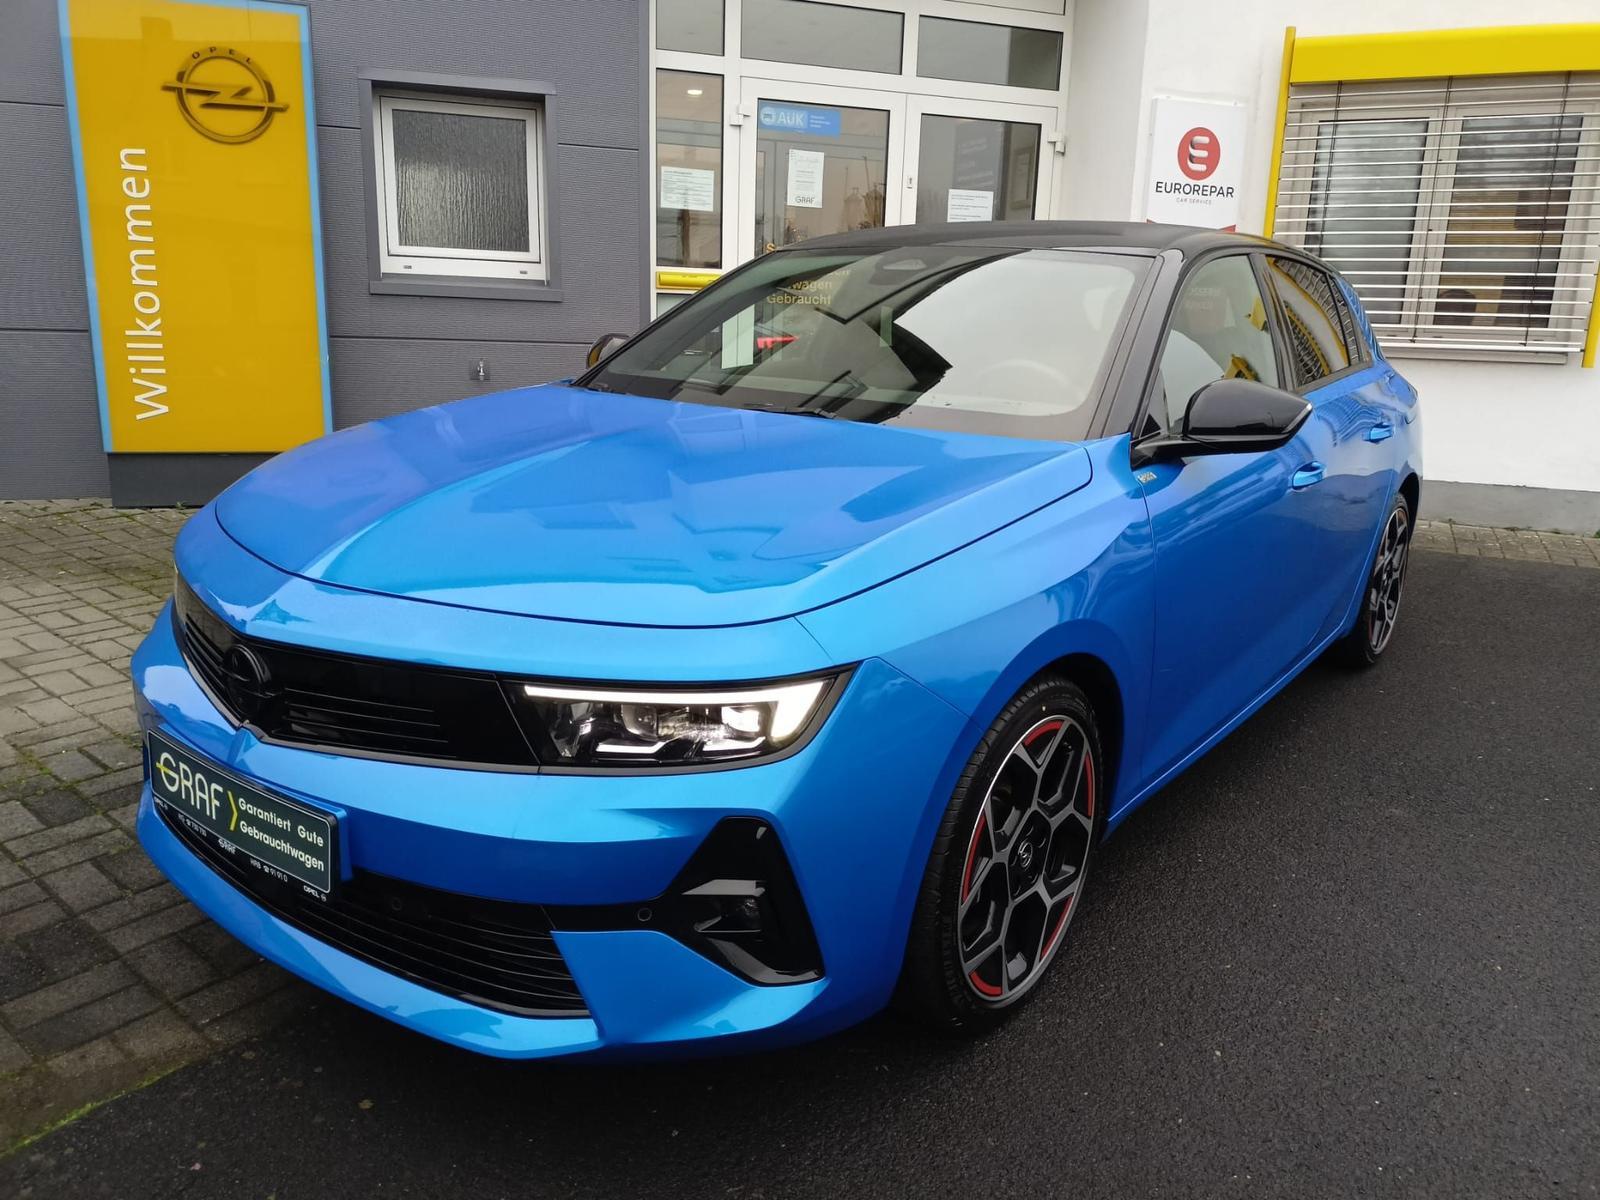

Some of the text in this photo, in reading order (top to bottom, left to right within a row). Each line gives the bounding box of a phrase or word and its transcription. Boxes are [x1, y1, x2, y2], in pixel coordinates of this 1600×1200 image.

[191, 46, 252, 64] OPEL
[795, 195, 815, 205] GRAF
[1155, 181, 1235, 198] EUROREPAR
[119, 147, 169, 421] Willkommen
[156, 752, 224, 820] GRAF
[238, 797, 324, 847] Garantiert Gute
[239, 820, 325, 872] Gebrauchtwagen
